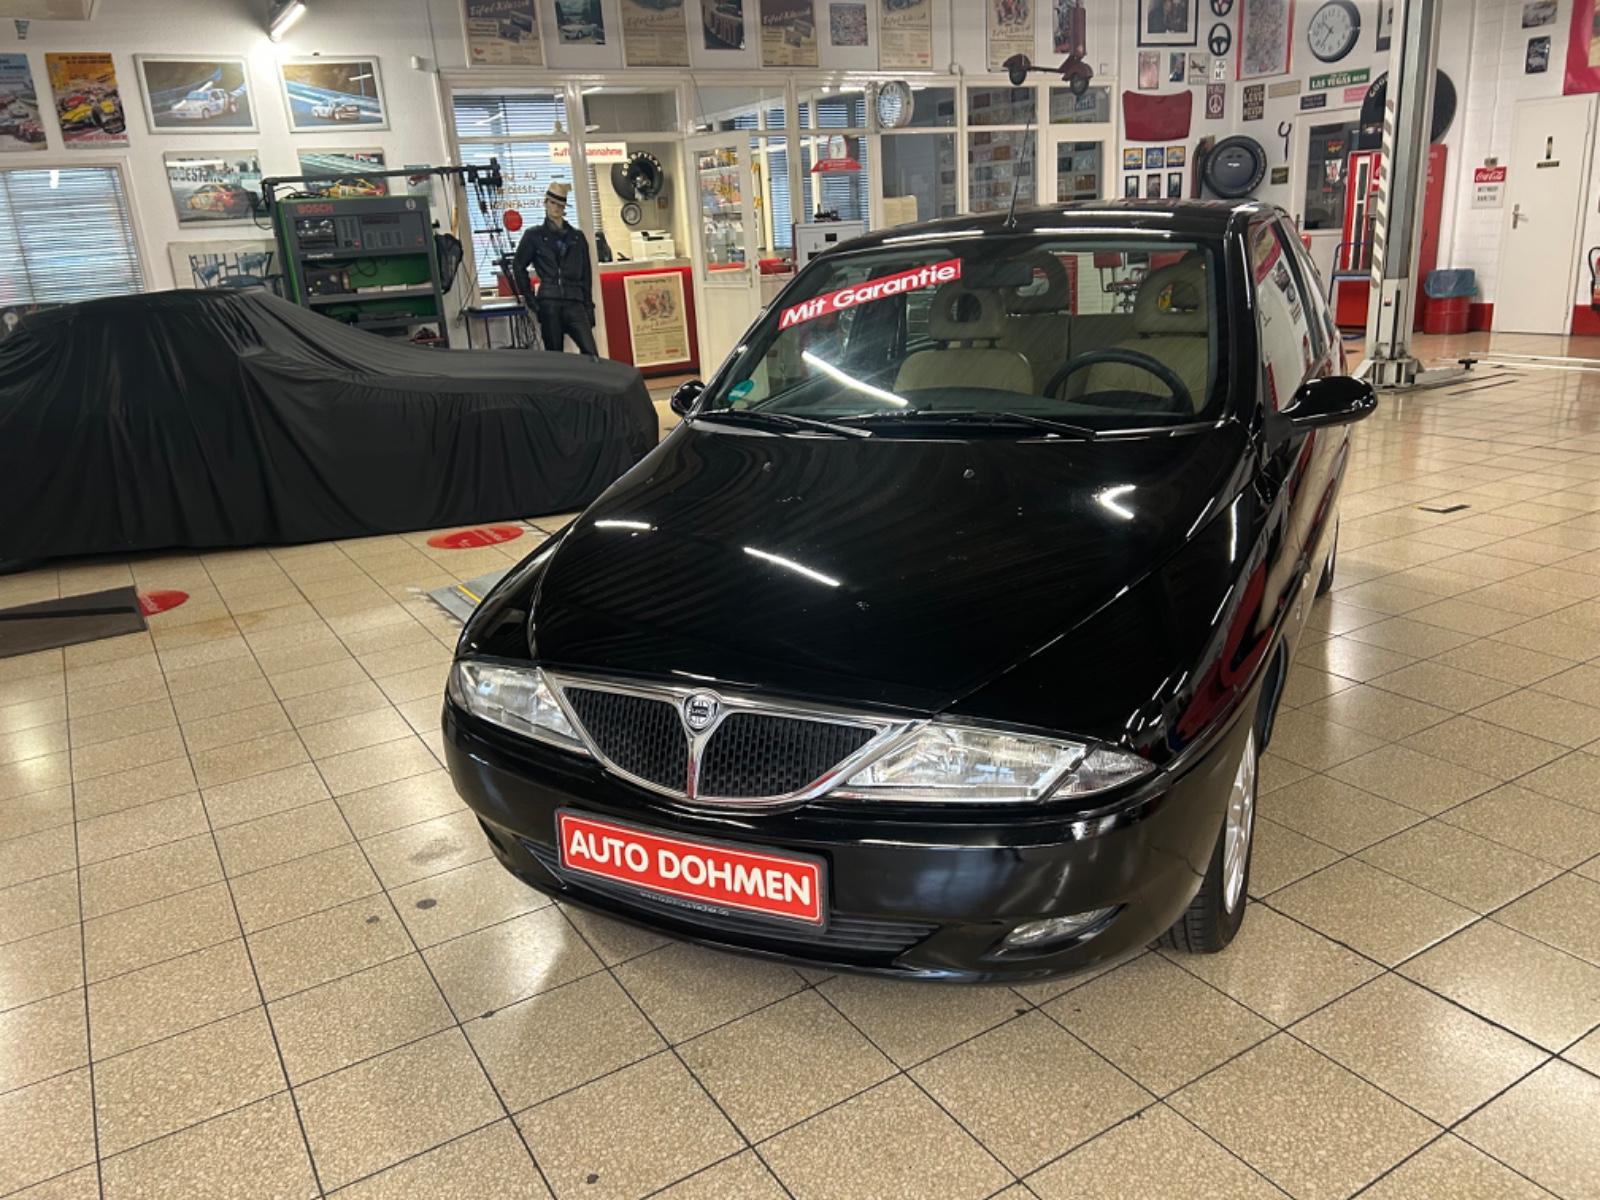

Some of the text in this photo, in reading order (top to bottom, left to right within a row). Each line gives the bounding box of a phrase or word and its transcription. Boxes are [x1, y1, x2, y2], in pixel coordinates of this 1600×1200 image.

[297, 203, 333, 215] BOSCH
[782, 264, 956, 328] Mit Garantie
[569, 829, 649, 873] AUTO
[657, 849, 811, 905] DOHMEN
